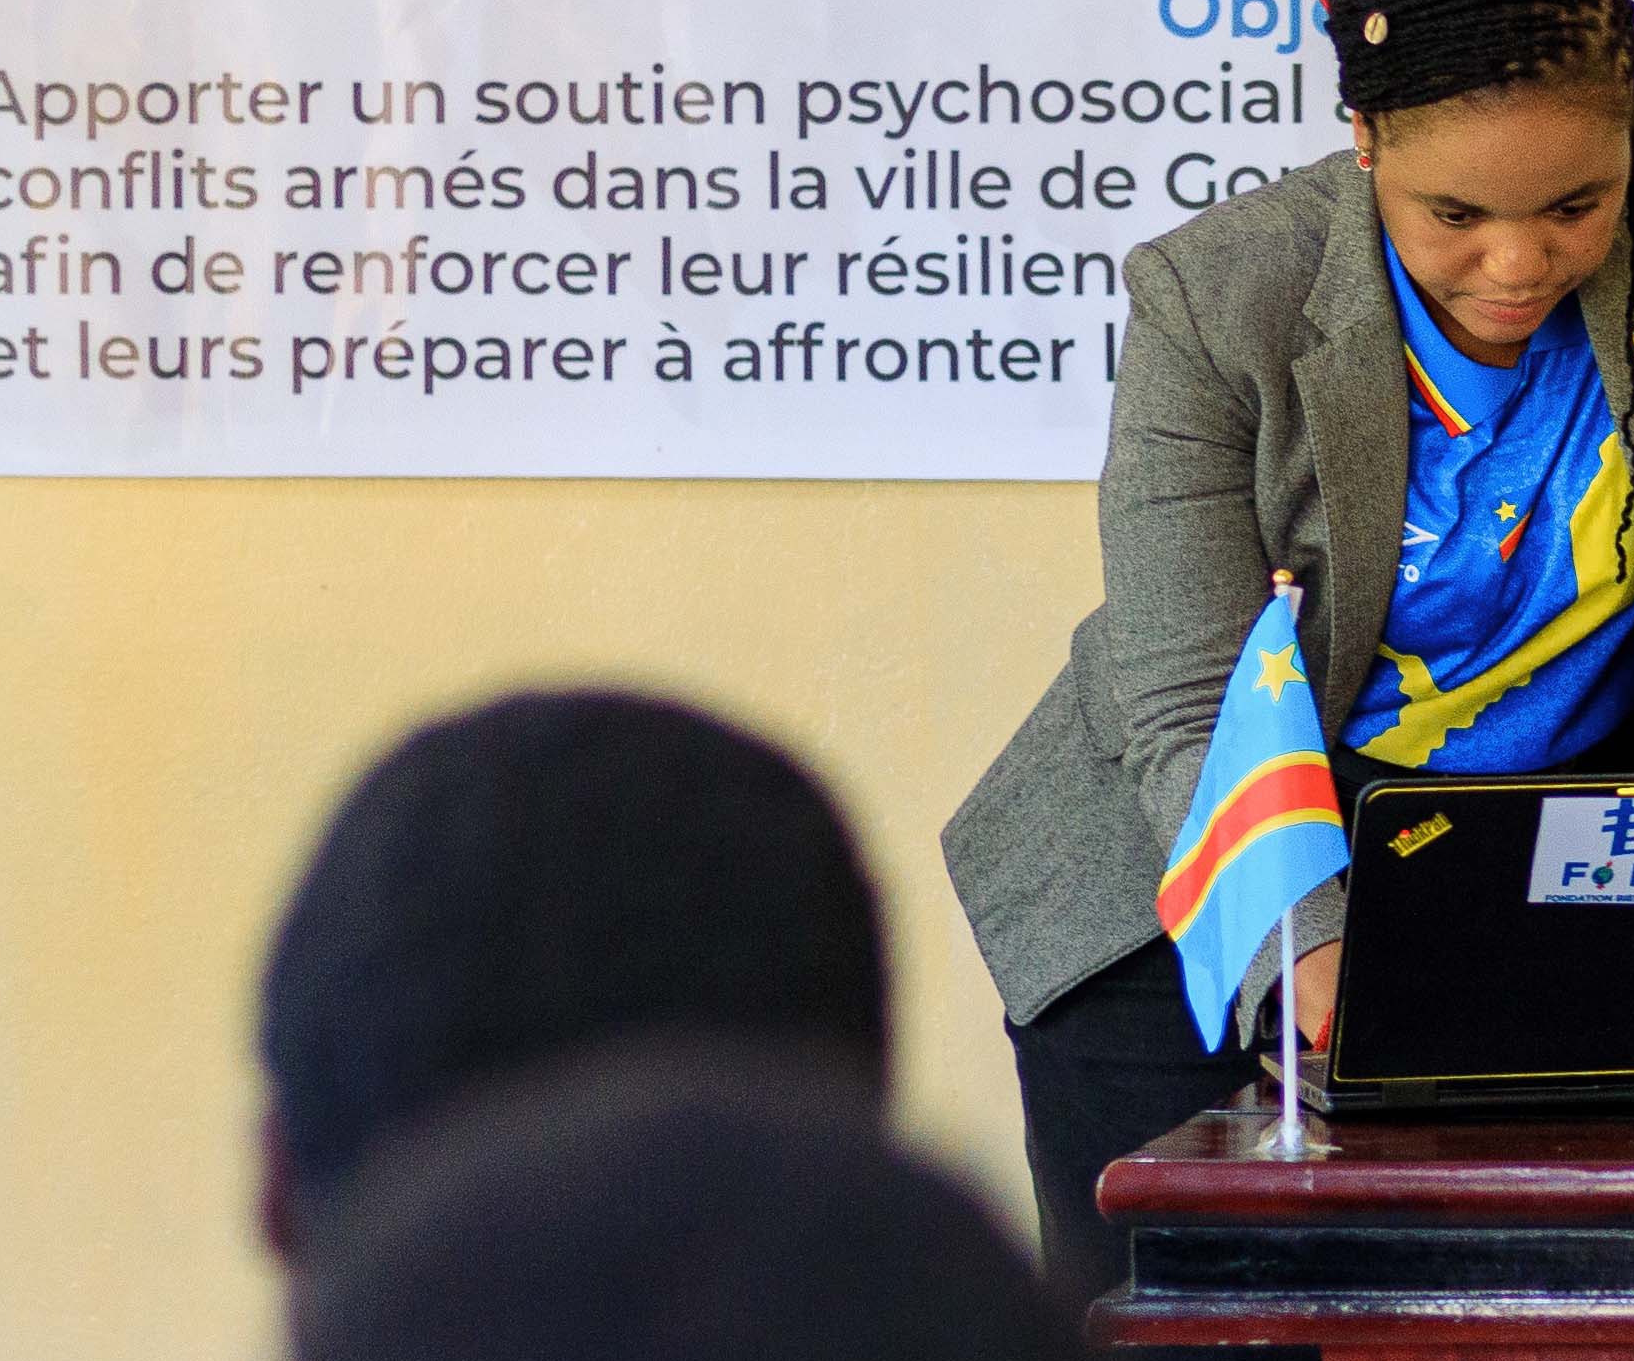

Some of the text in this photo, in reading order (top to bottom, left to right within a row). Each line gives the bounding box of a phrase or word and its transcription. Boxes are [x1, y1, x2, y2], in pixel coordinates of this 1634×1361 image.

[351, 79, 446, 126] un
[474, 61, 766, 126] soutien
[797, 61, 1304, 141] psychosocial
[284, 148, 527, 211] armés
[551, 149, 741, 212] dans
[768, 149, 828, 211] la
[854, 146, 1013, 211] ville
[1038, 148, 1136, 211] de
[149, 233, 245, 297] de
[273, 233, 632, 297] renforcer
[660, 233, 810, 297] leur
[836, 232, 1115, 298] résilien
[78, 319, 264, 383] leurs
[291, 320, 628, 397] préparer
[653, 320, 694, 384] à
[722, 320, 1076, 384] affronter
[1545, 894, 1613, 903] FONDATION
